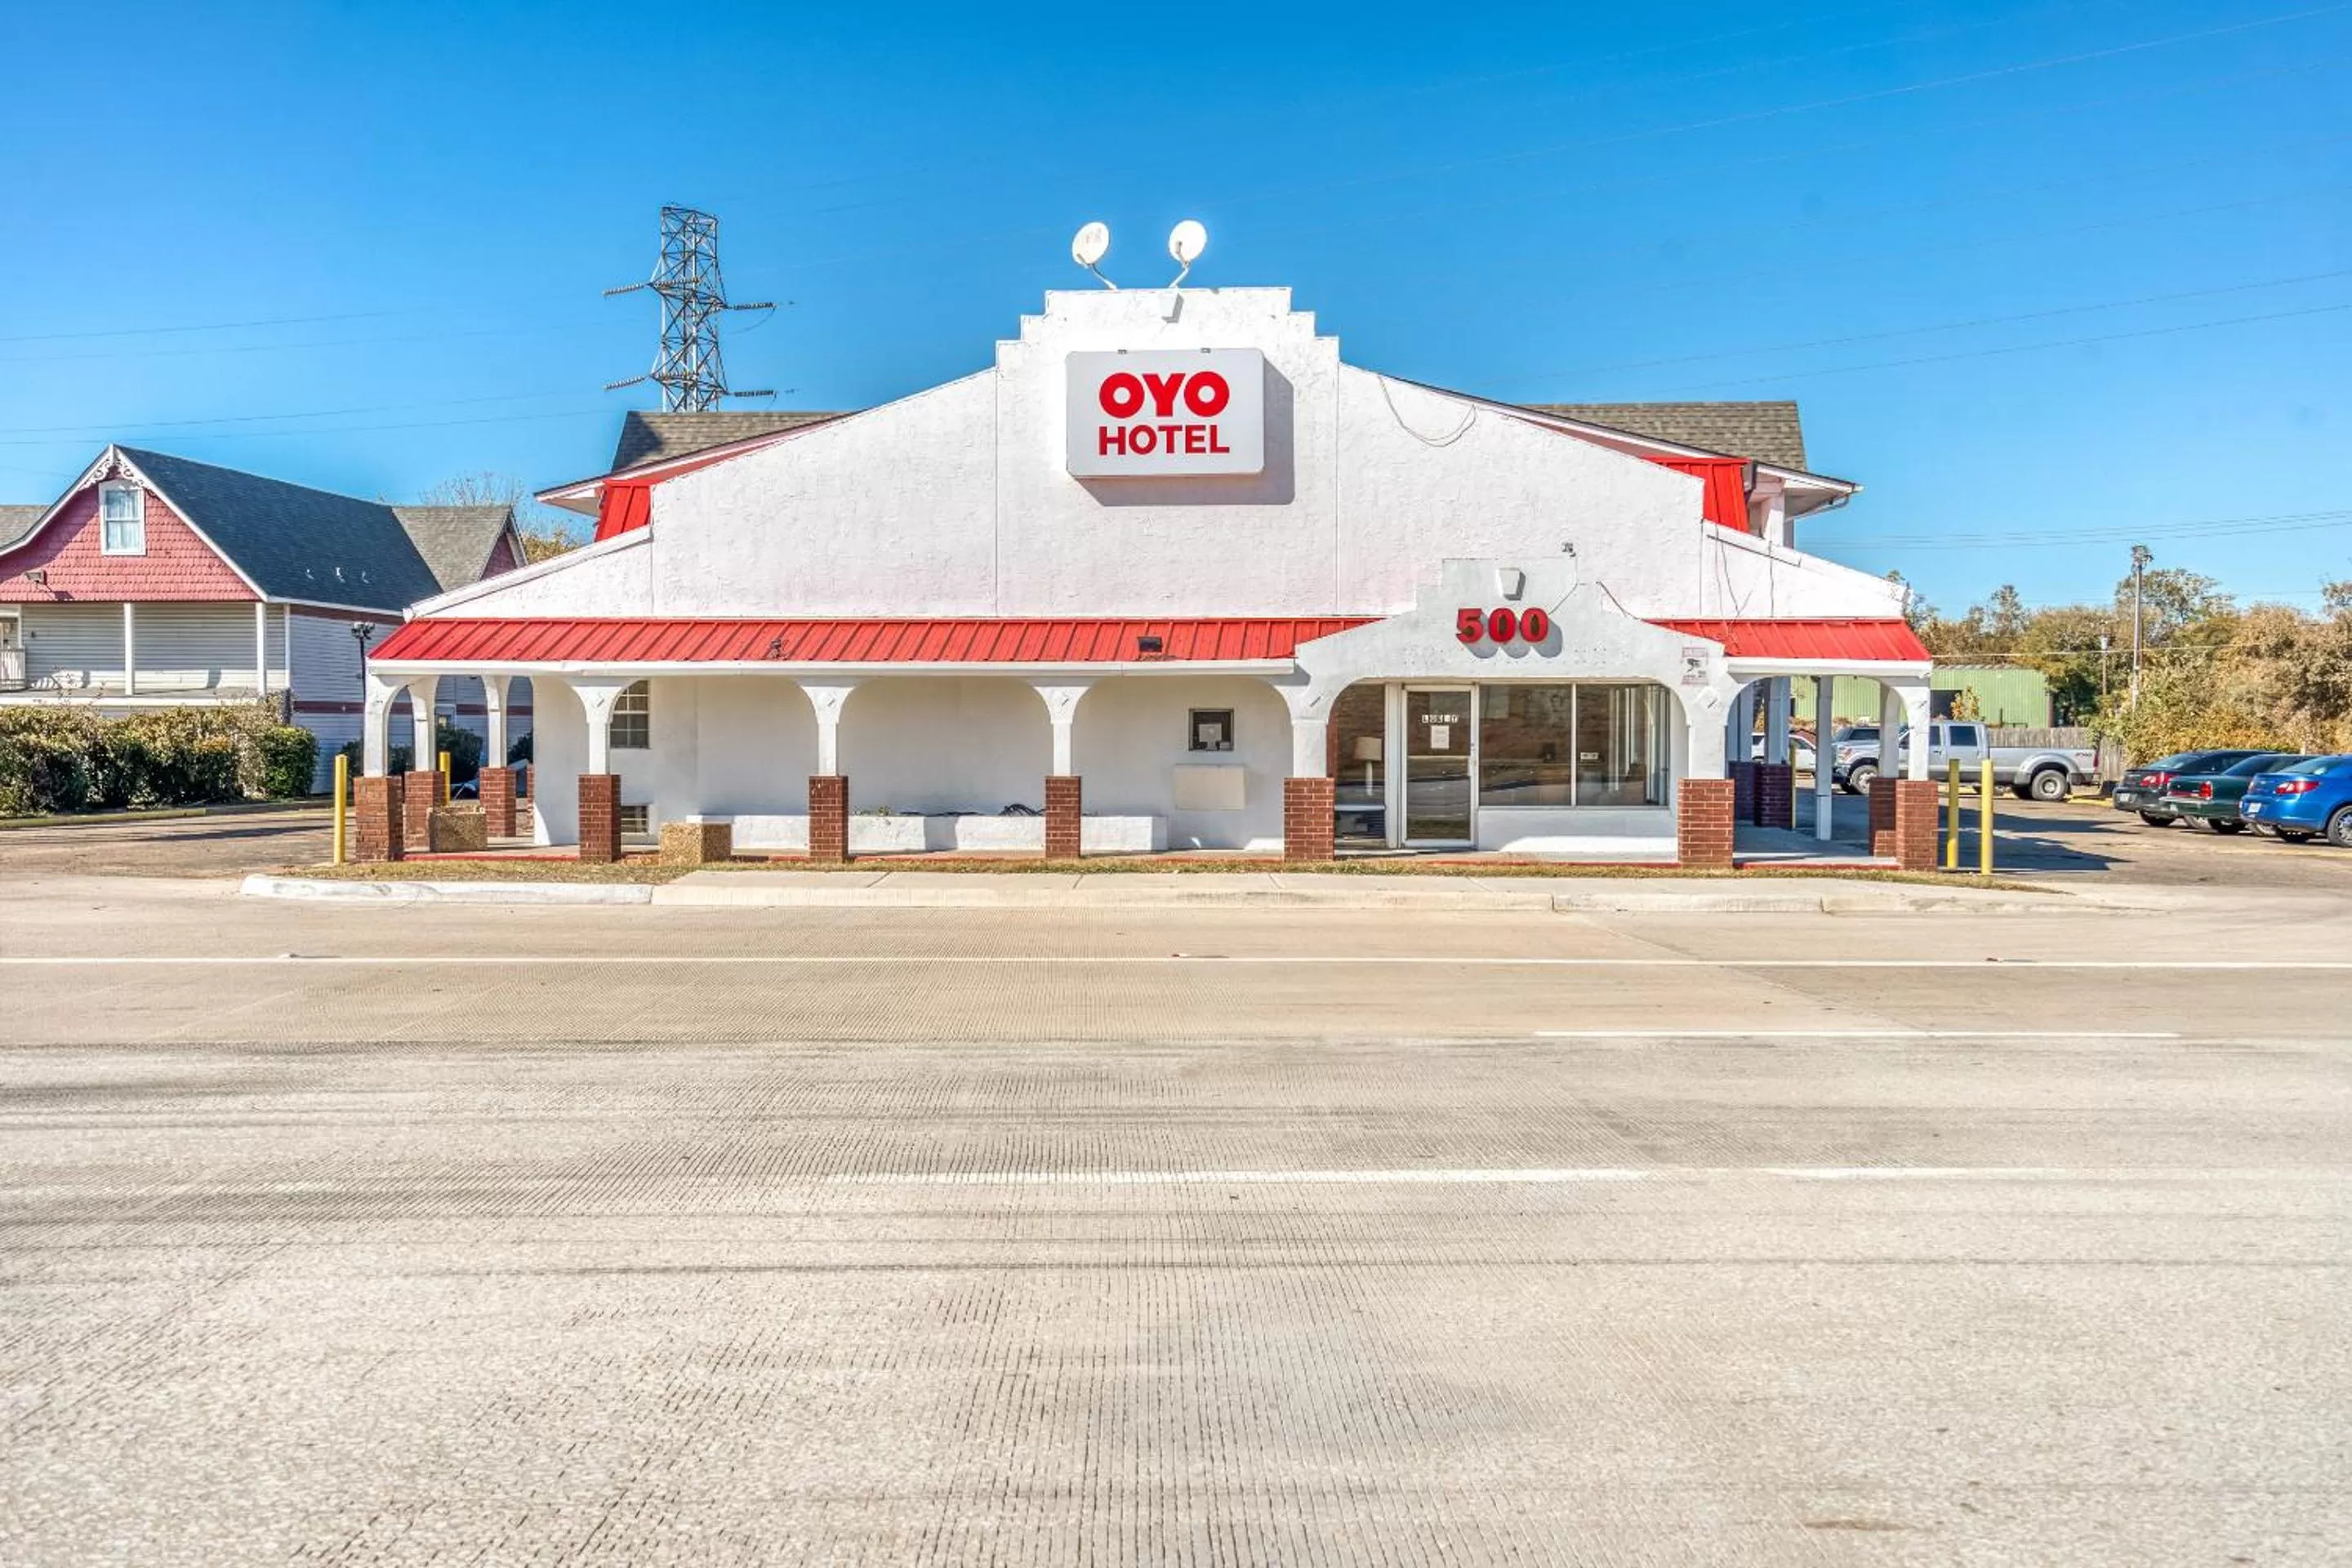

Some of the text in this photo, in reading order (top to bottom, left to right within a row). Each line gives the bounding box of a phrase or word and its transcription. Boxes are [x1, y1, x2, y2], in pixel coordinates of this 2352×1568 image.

[1098, 371, 1230, 419] OYO
[1098, 425, 1230, 455] HOTEL
[1455, 608, 1549, 644] 500
